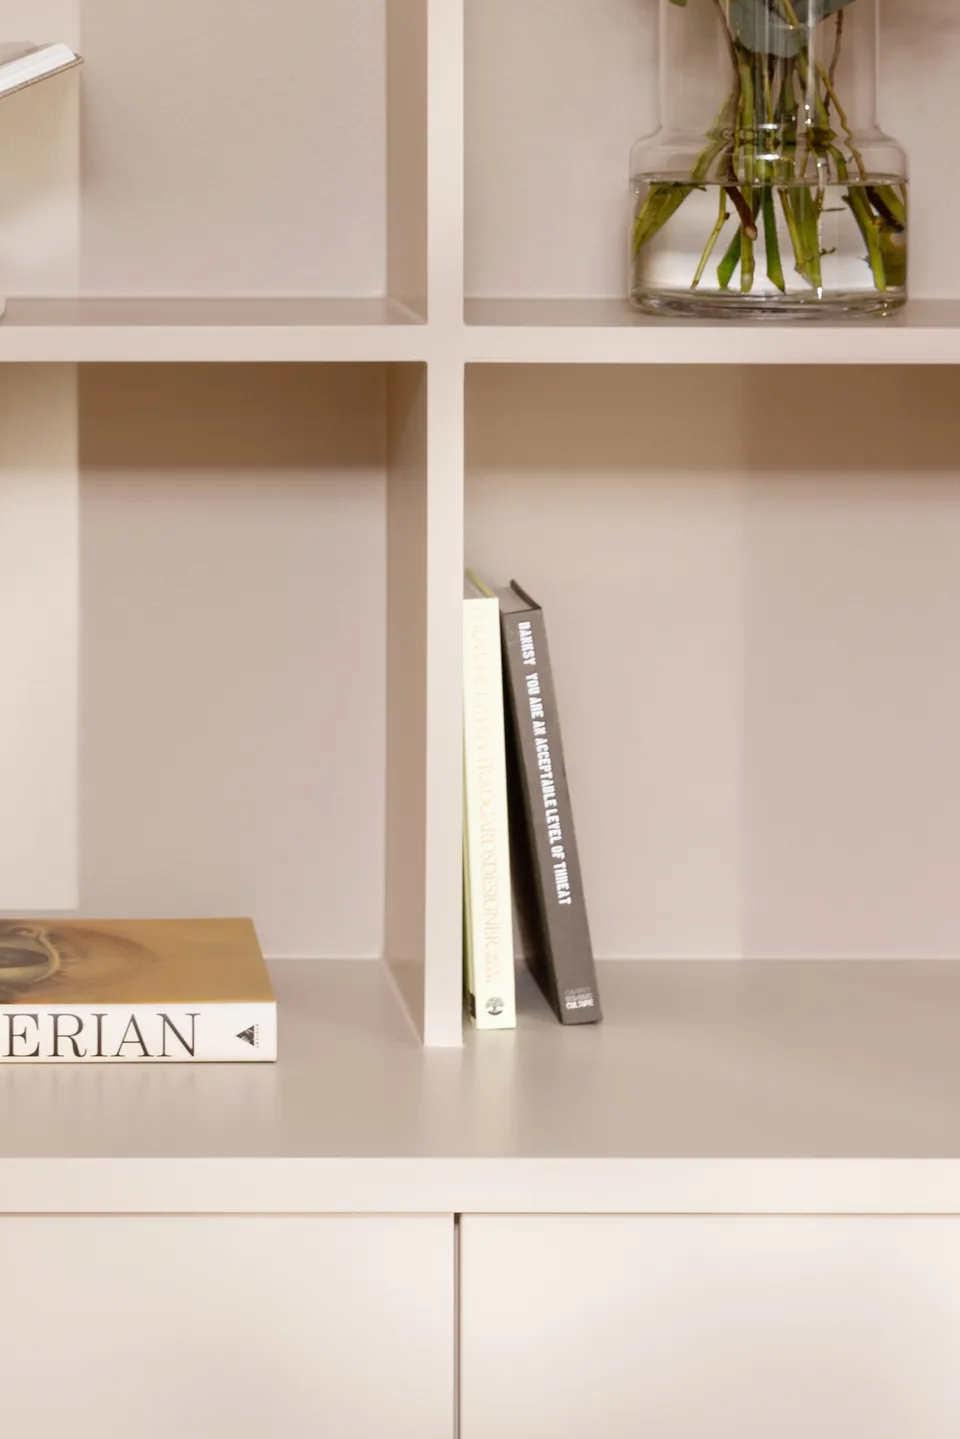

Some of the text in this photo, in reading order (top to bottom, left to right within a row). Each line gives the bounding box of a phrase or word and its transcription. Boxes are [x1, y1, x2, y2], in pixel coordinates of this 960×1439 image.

[517, 621, 572, 906] BANKSY YOU ARE AN ACCEPTABLE LEVEL OF THREAT
